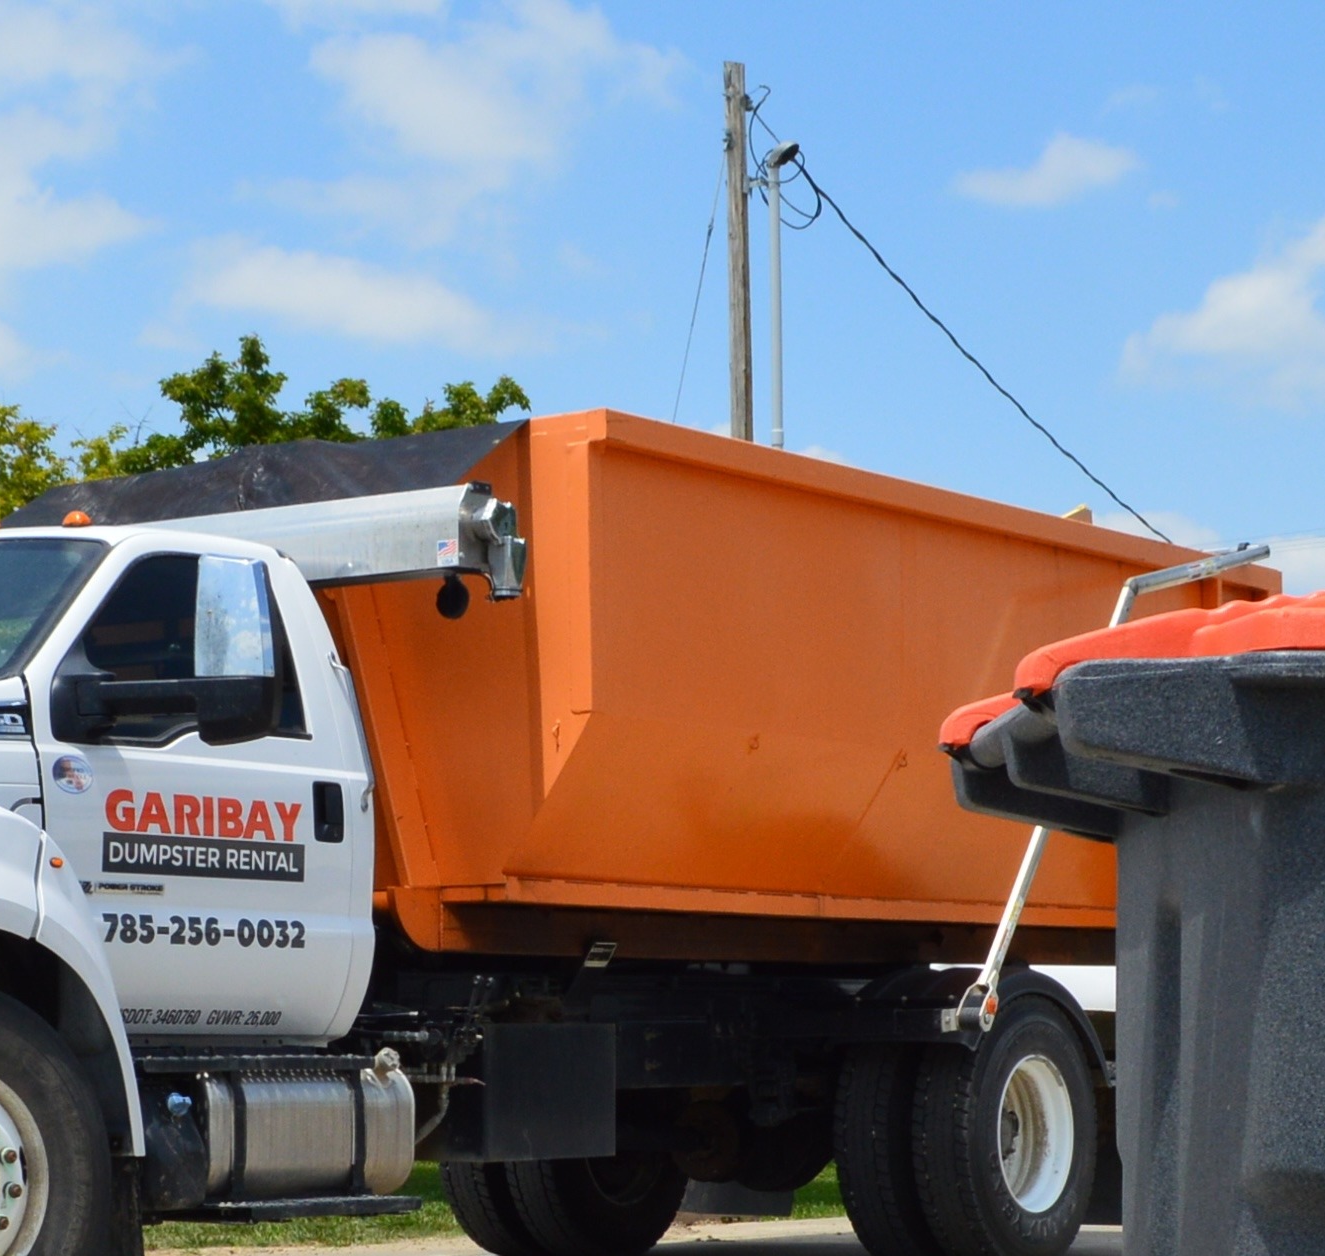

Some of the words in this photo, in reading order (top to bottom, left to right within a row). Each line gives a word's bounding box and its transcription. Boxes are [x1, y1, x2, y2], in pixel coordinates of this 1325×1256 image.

[104, 788, 303, 842] GARIBAY
[108, 840, 220, 869] DUMPSTER
[226, 848, 300, 873] RENTAL
[101, 912, 306, 949] 785-256-0032
[120, 1008, 152, 1024] SDOT:
[152, 1009, 202, 1025] 3460760
[206, 1009, 244, 1026] GVWR:
[244, 1010, 283, 1028] 26,000
